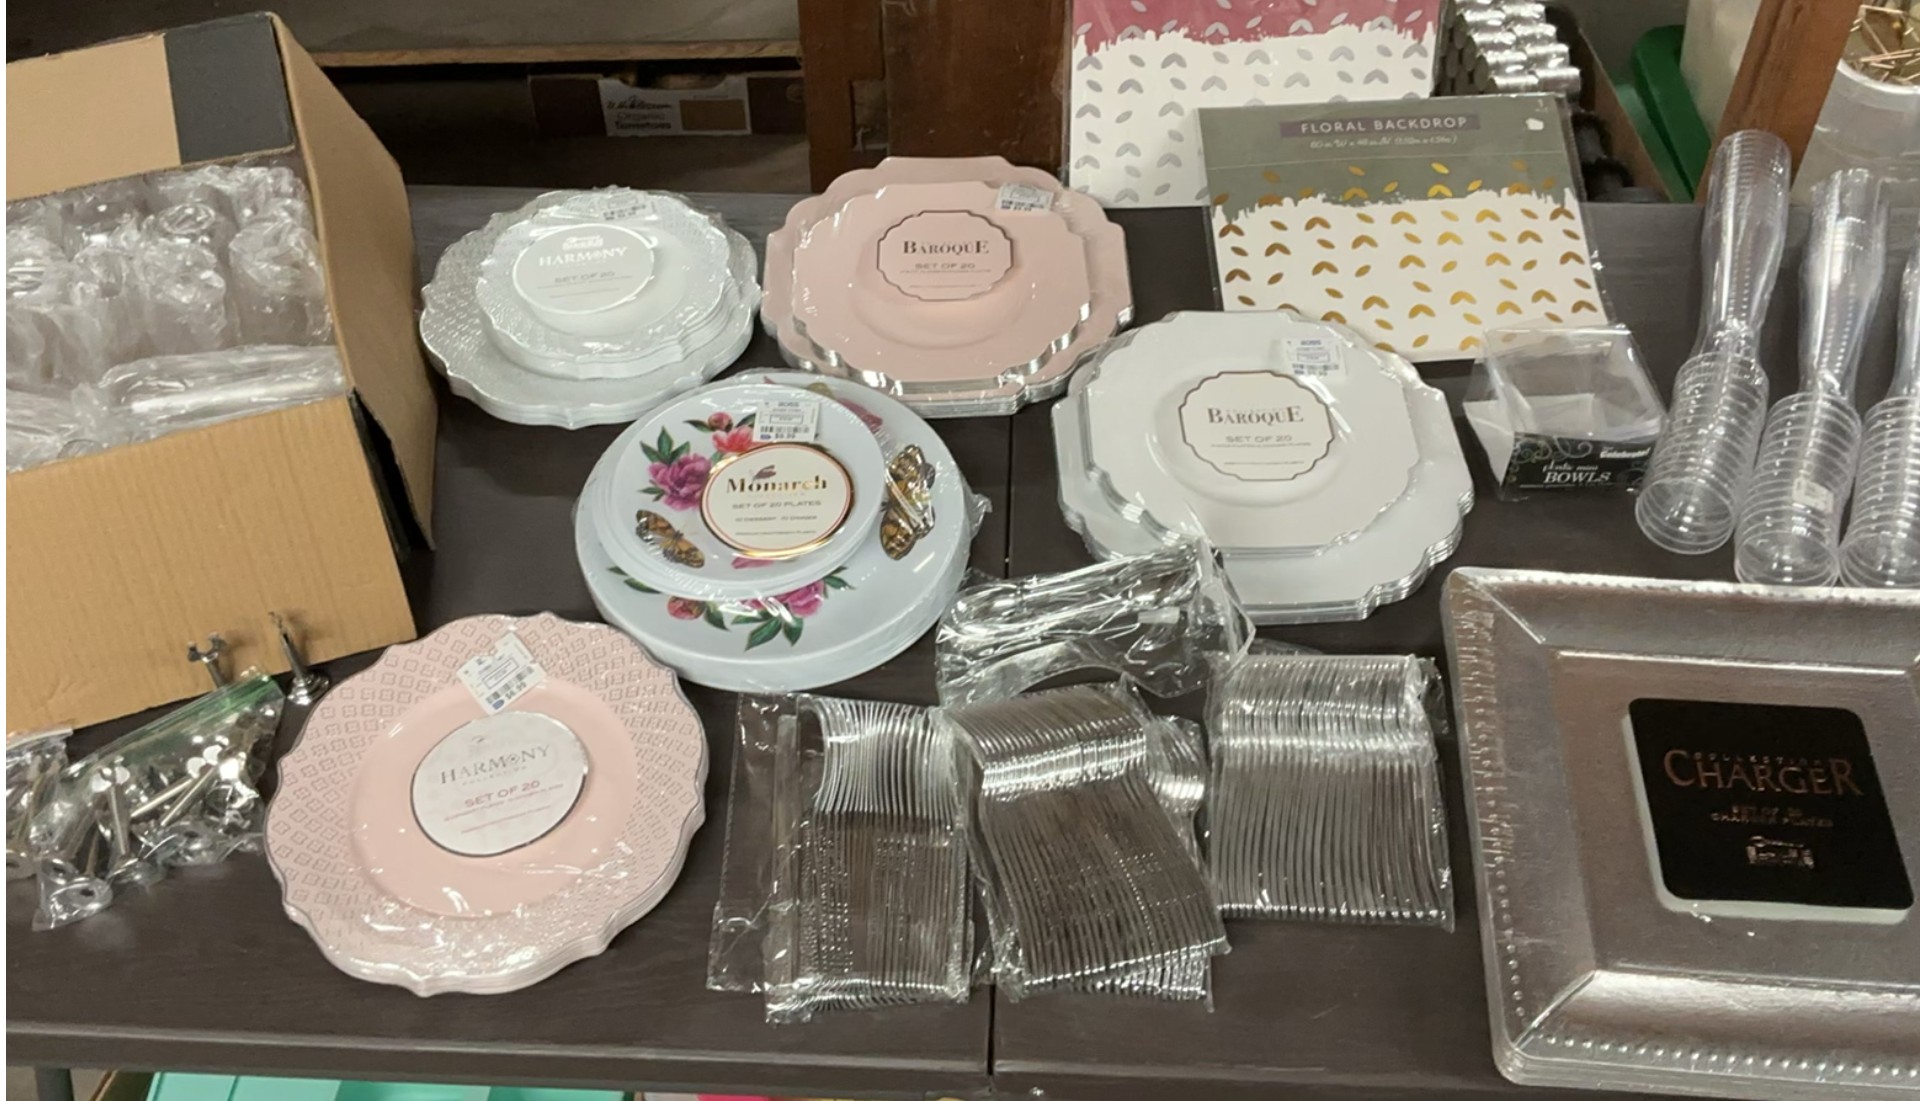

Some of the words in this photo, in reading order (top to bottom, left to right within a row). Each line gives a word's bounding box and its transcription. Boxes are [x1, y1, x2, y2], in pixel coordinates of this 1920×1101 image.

[1301, 121, 1366, 134] FLORAL
[1374, 117, 1467, 131] BACKDROP
[538, 246, 629, 267] HARMONY
[903, 240, 989, 256] BAROQUE
[555, 274, 578, 283] SET
[580, 272, 599, 281] OF
[1207, 405, 1304, 426] BAROQUE
[1254, 435, 1273, 443] OF
[726, 475, 828, 494] Monarch
[1543, 471, 1612, 484] BOWLS
[440, 744, 551, 785] HARMONY
[1664, 749, 1864, 796] CHARGER
[464, 793, 494, 807] SET
[497, 786, 519, 798] OF
[521, 780, 541, 792] 20
